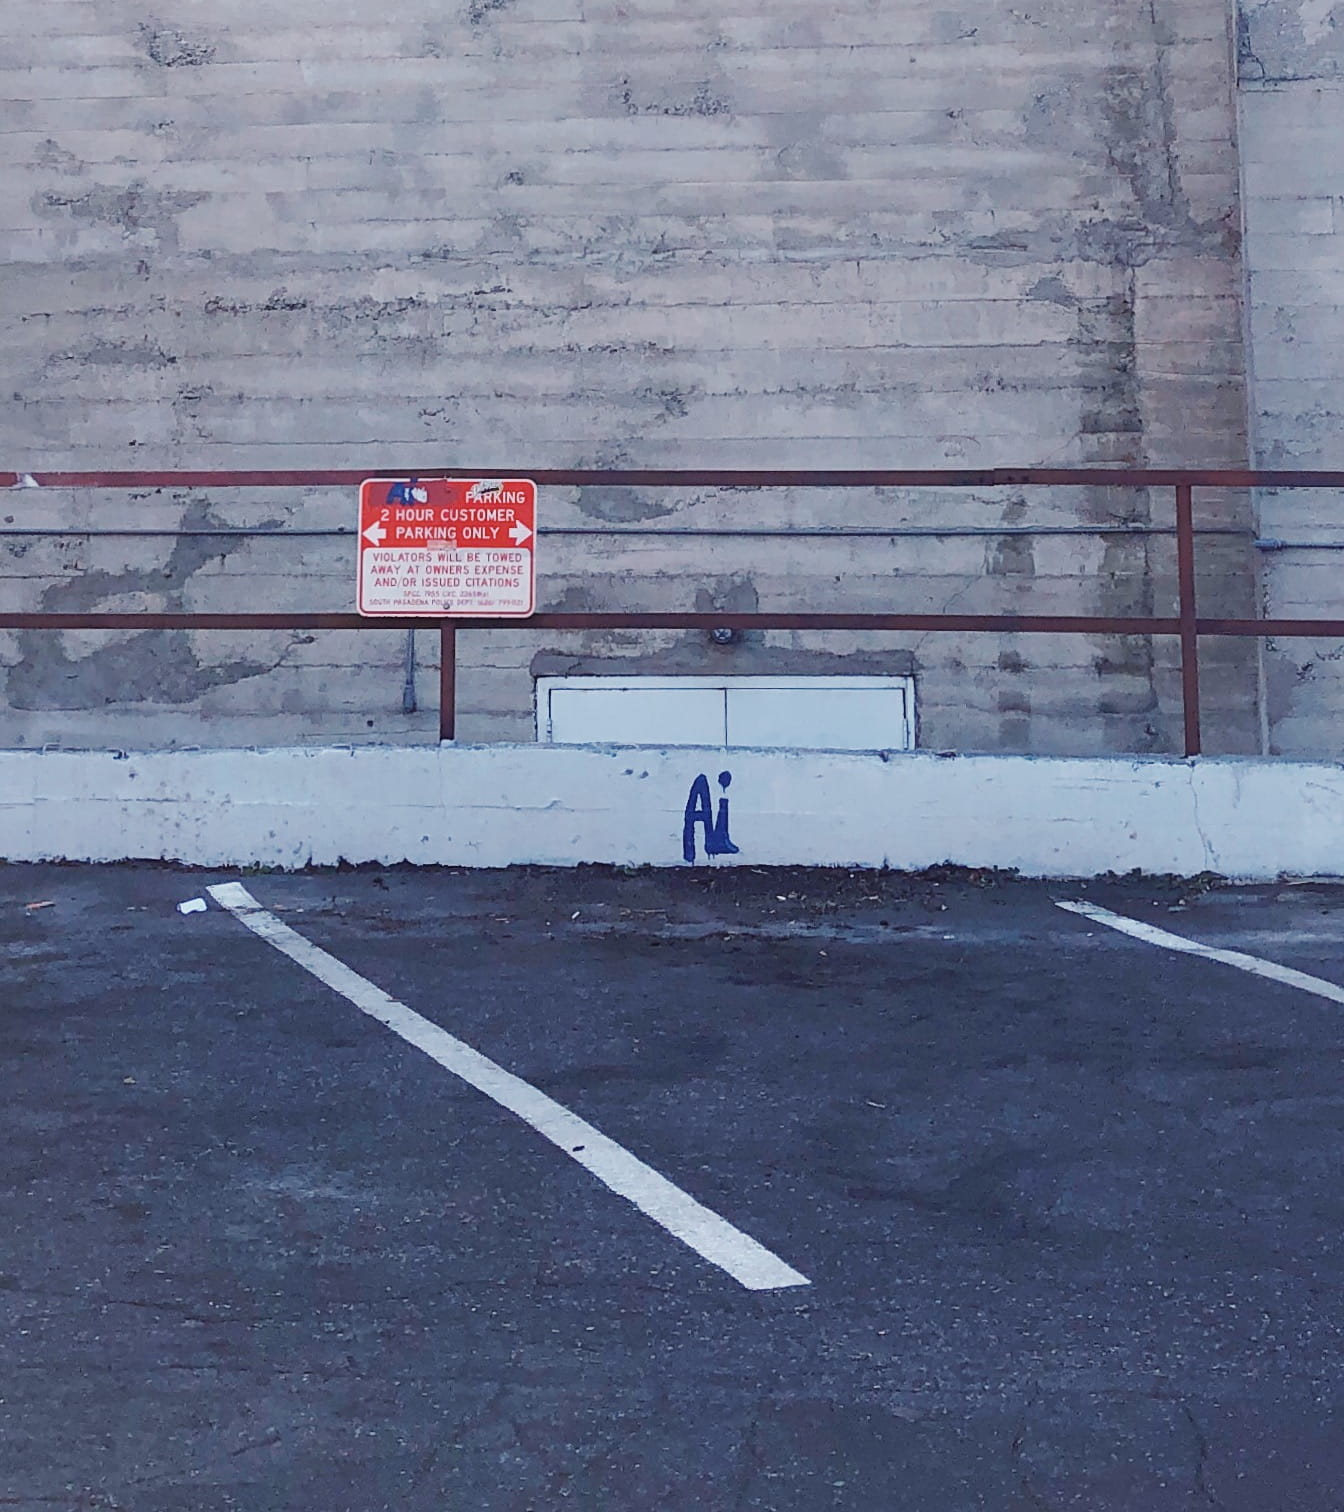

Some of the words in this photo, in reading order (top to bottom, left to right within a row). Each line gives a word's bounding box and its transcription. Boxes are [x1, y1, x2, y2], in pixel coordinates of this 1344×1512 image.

[465, 491, 525, 504] PARKING
[381, 509, 390, 522] 2
[396, 509, 433, 521] HOUR
[440, 509, 515, 522] CUSTOMER
[395, 527, 457, 539] PARKING
[463, 526, 500, 539] ONLY
[373, 553, 432, 563] VIOLATORS
[437, 553, 462, 563] WILL
[467, 552, 480, 562] BE
[486, 552, 522, 562] TOWED
[370, 566, 401, 575] AWAY
[407, 566, 419, 575] AT
[425, 565, 469, 575] OWNERS
[474, 565, 524, 575] EXPENSE
[374, 578, 416, 587] AND/OR
[422, 578, 460, 587] ISSUED
[466, 578, 519, 587] CITATIONS
[682, 770, 740, 864] Ai
